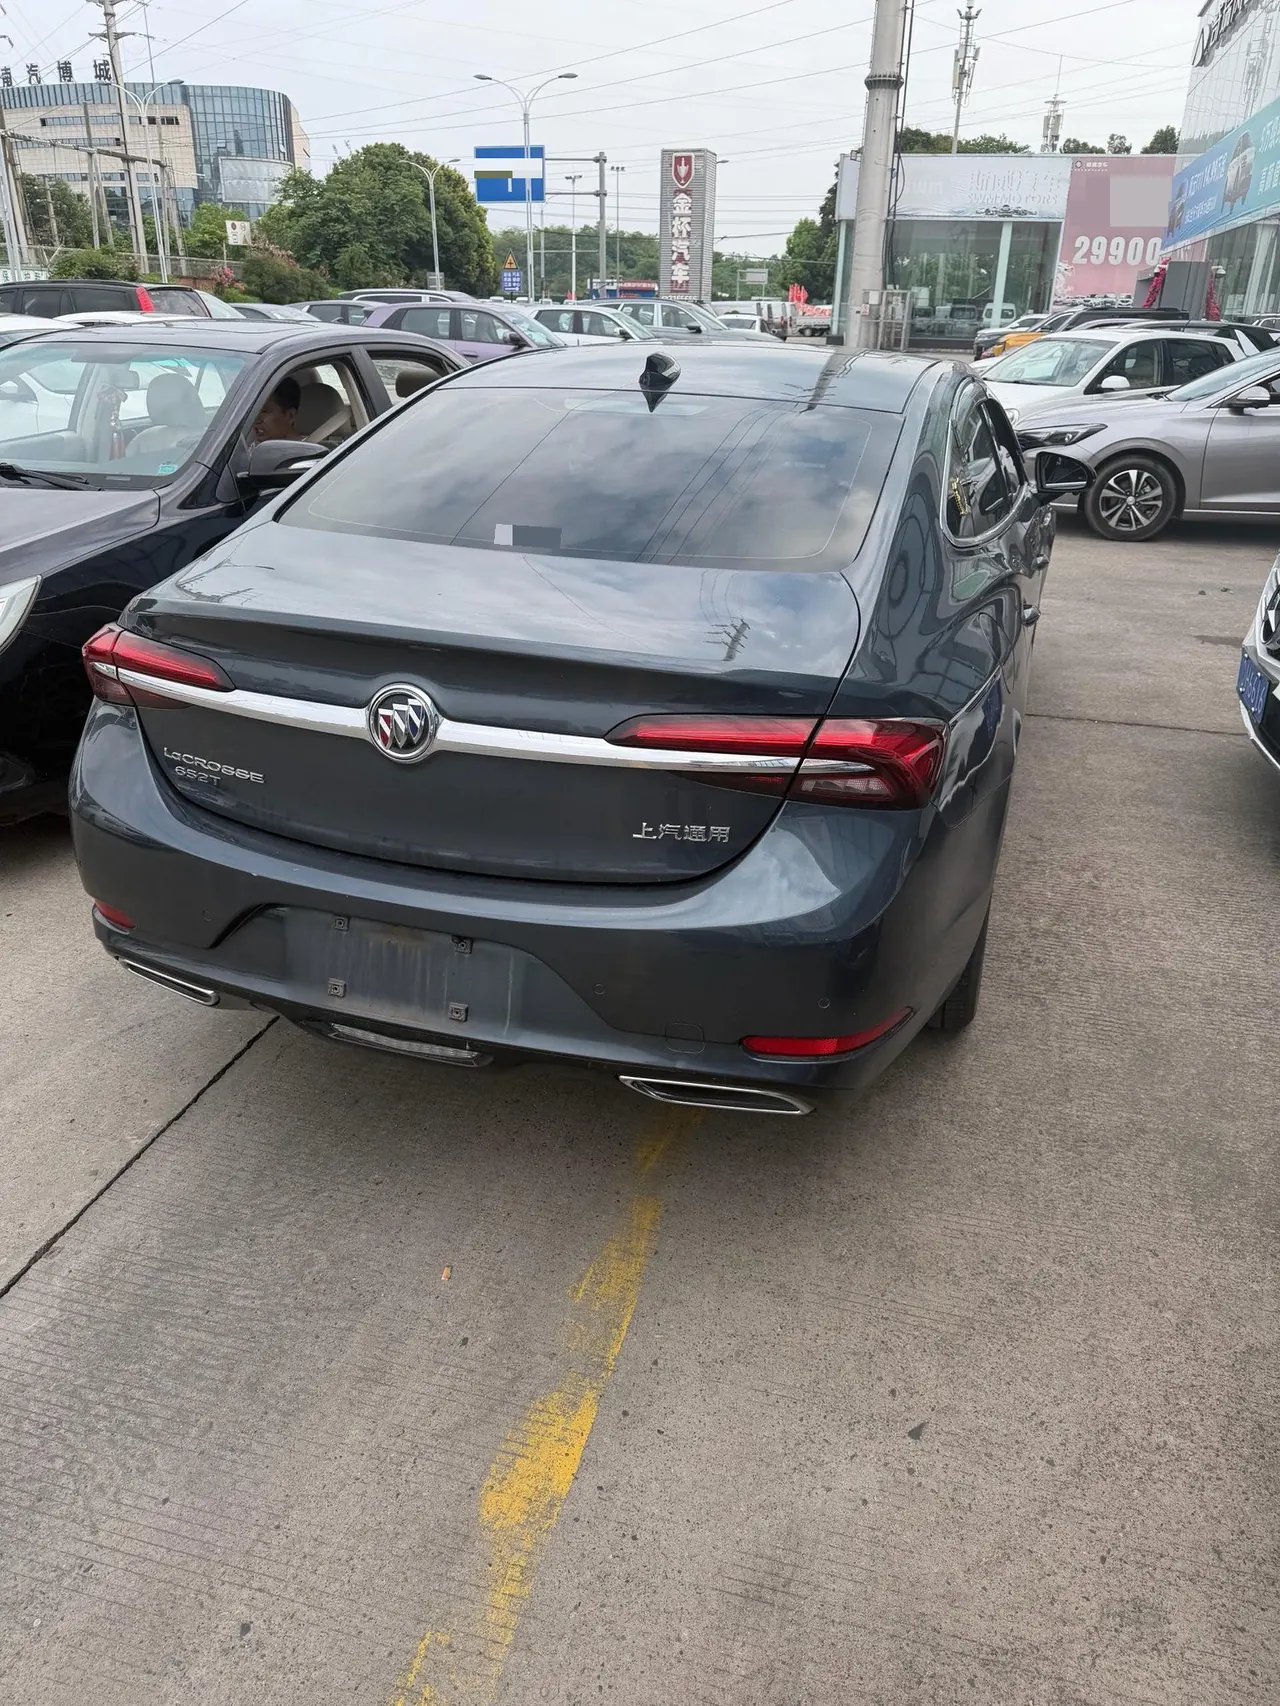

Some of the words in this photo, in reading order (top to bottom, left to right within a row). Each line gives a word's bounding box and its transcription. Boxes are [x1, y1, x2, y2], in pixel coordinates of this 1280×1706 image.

[671, 192, 693, 285] 金杯汽车
[1071, 235, 1163, 266] 29900
[174, 766, 221, 786] 652T
[632, 822, 731, 843] 上汽通用
